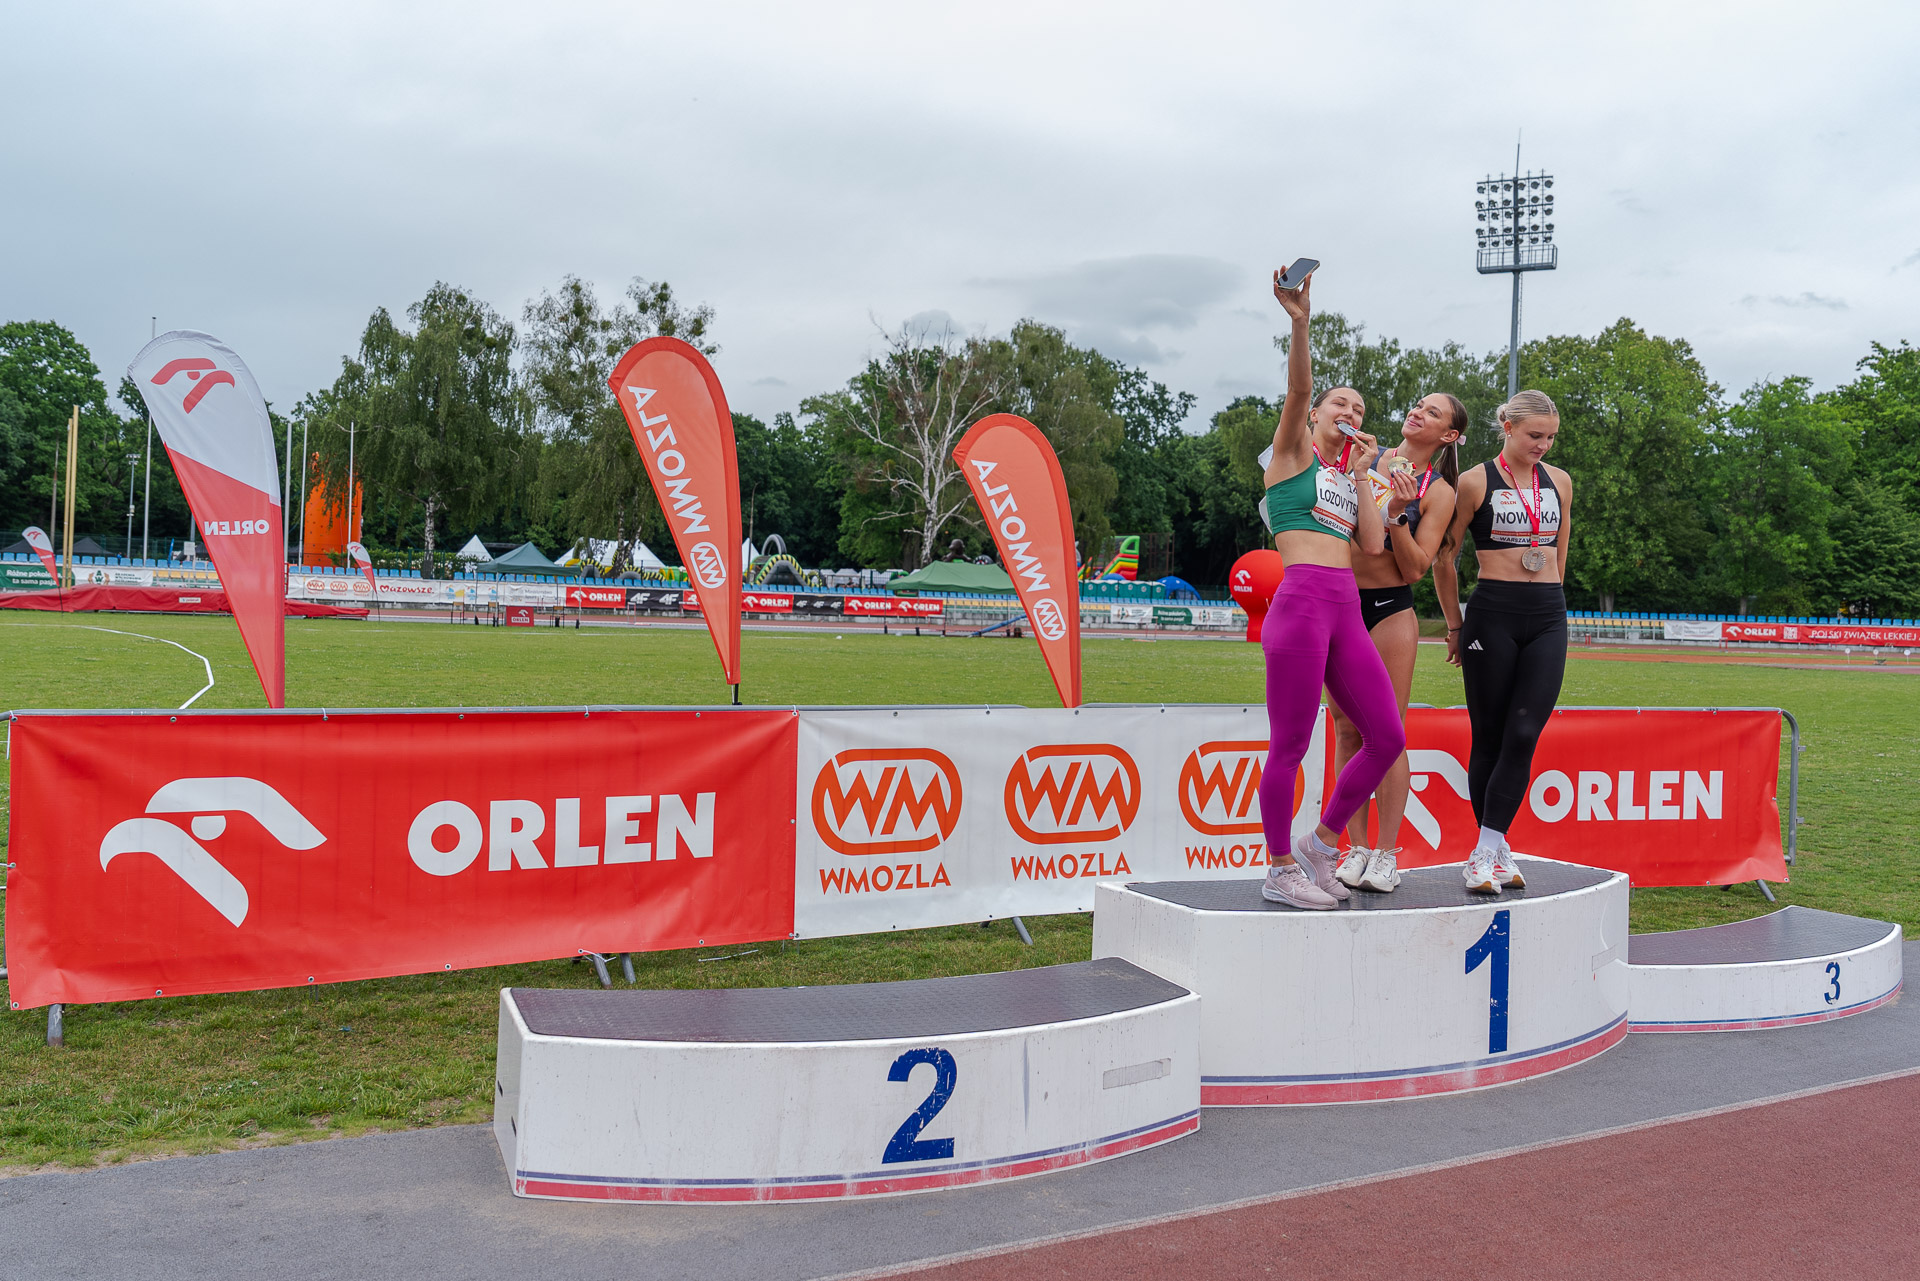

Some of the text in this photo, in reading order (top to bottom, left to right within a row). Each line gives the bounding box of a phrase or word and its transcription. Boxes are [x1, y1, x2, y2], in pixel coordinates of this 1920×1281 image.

[1495, 511, 1558, 524] NOWKA
[588, 593, 621, 602] ORLEN
[630, 593, 679, 605] 4F 4F
[759, 598, 789, 607] ORLEN
[863, 602, 891, 610] ORLEN
[913, 603, 940, 611] ORLEN
[1744, 628, 1776, 636] ORLEN
[1811, 630, 1917, 641] POLSKI ZWIĄZEK LEKKIEJ
[1529, 769, 1723, 822] ORLEN
[407, 792, 716, 876] ORLEN
[1010, 851, 1132, 881] WMOZLA
[1185, 844, 1273, 870] WMOZL
[819, 862, 951, 895] WMOZLA
[1465, 909, 1510, 1054] 1
[1824, 961, 1840, 1005] 3
[881, 1046, 957, 1164] 2
